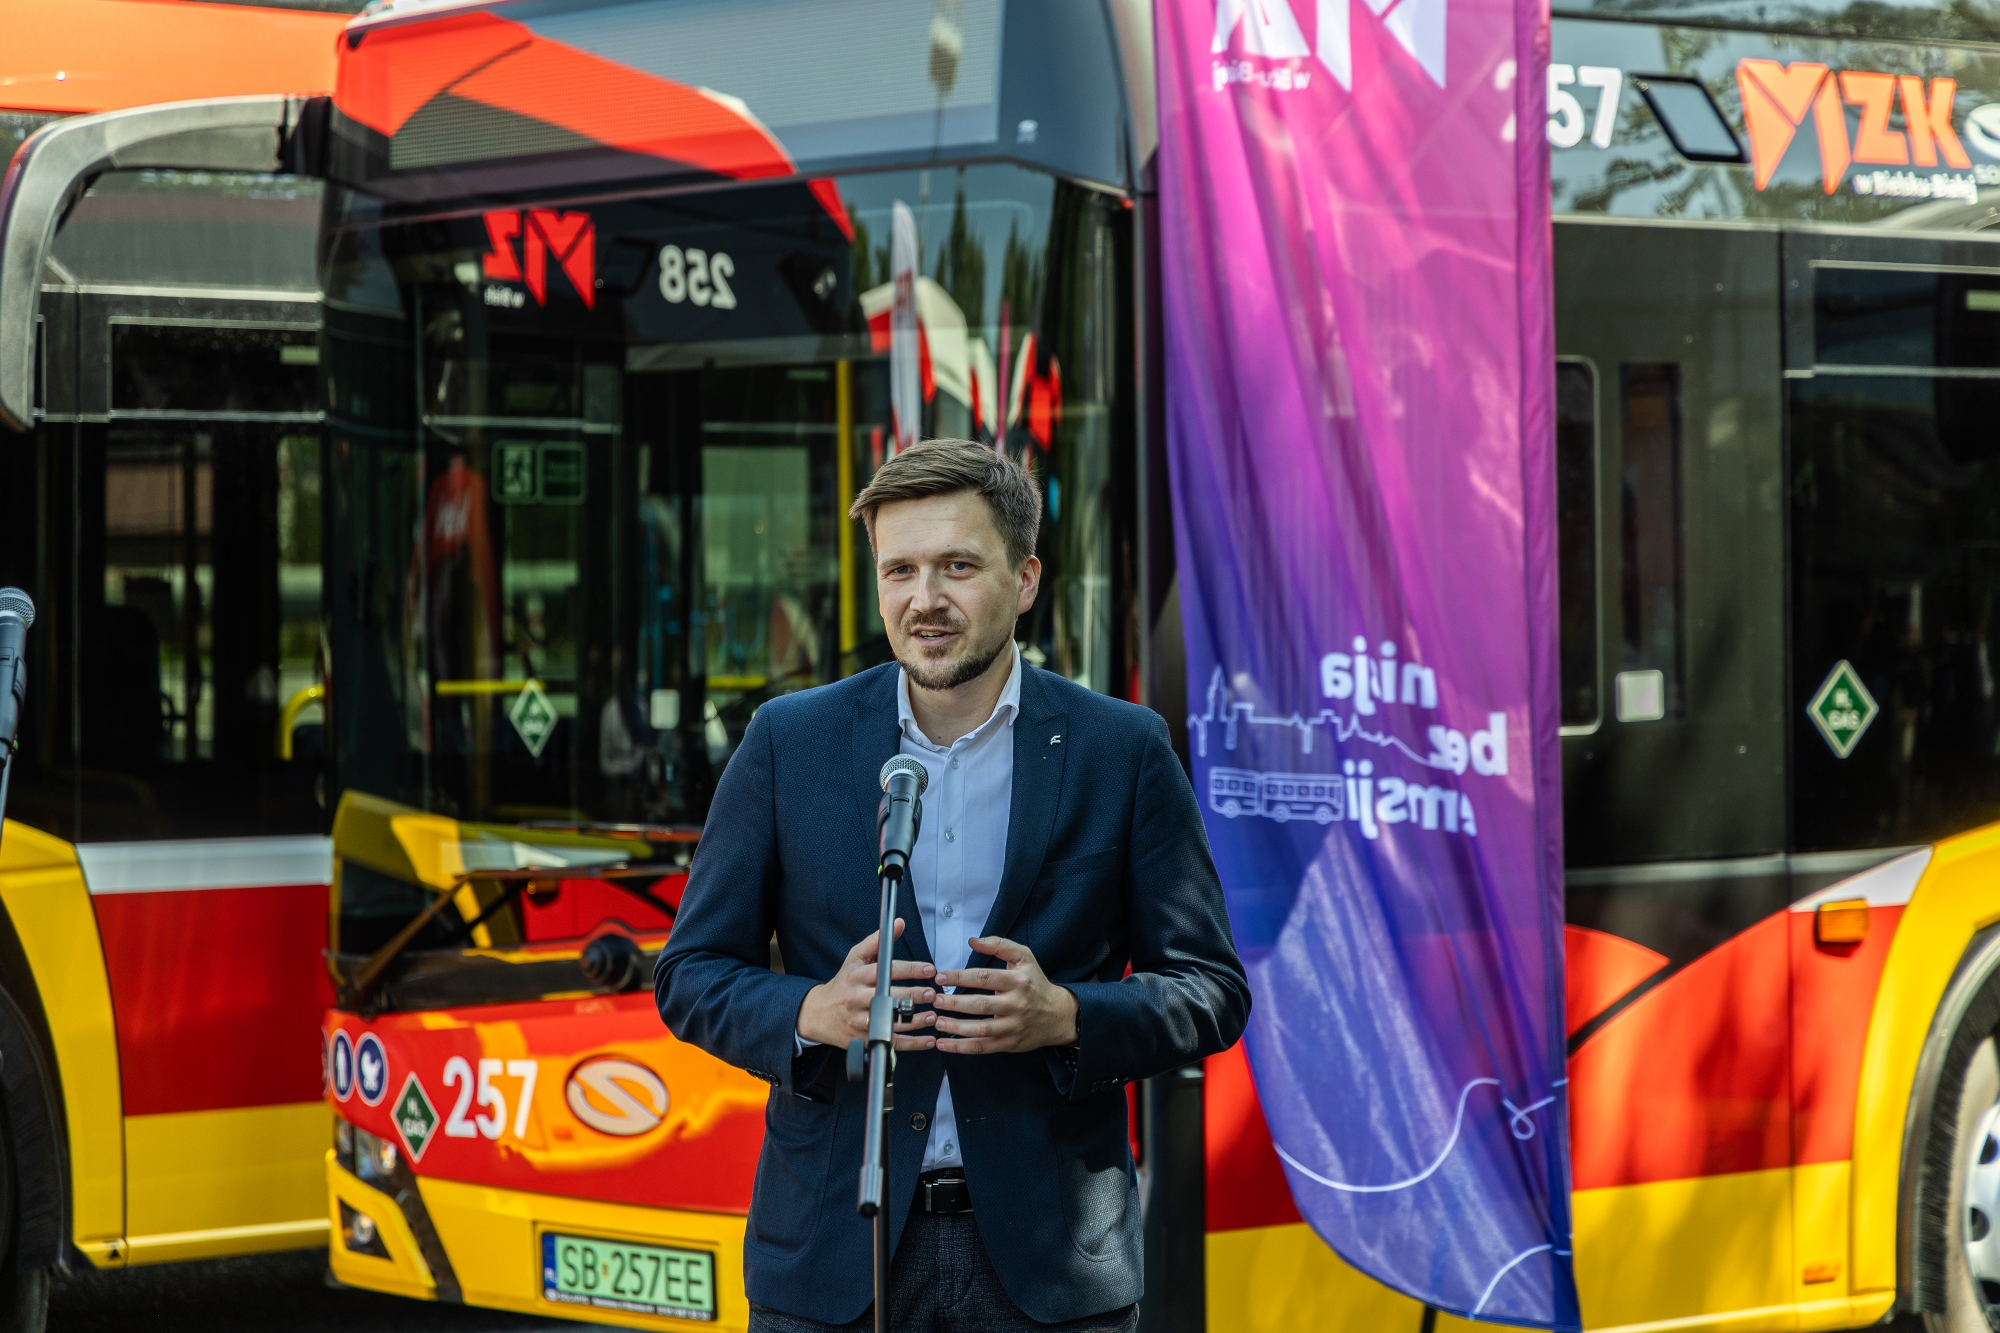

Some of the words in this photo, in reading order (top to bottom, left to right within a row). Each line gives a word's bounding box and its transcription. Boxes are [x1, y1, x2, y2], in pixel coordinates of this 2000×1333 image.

[1735, 57, 1973, 196] MZK
[1853, 173, 1873, 196] w
[1828, 709, 1860, 731] GAS
[442, 1055, 538, 1140] 257
[402, 1117, 428, 1138] GAS
